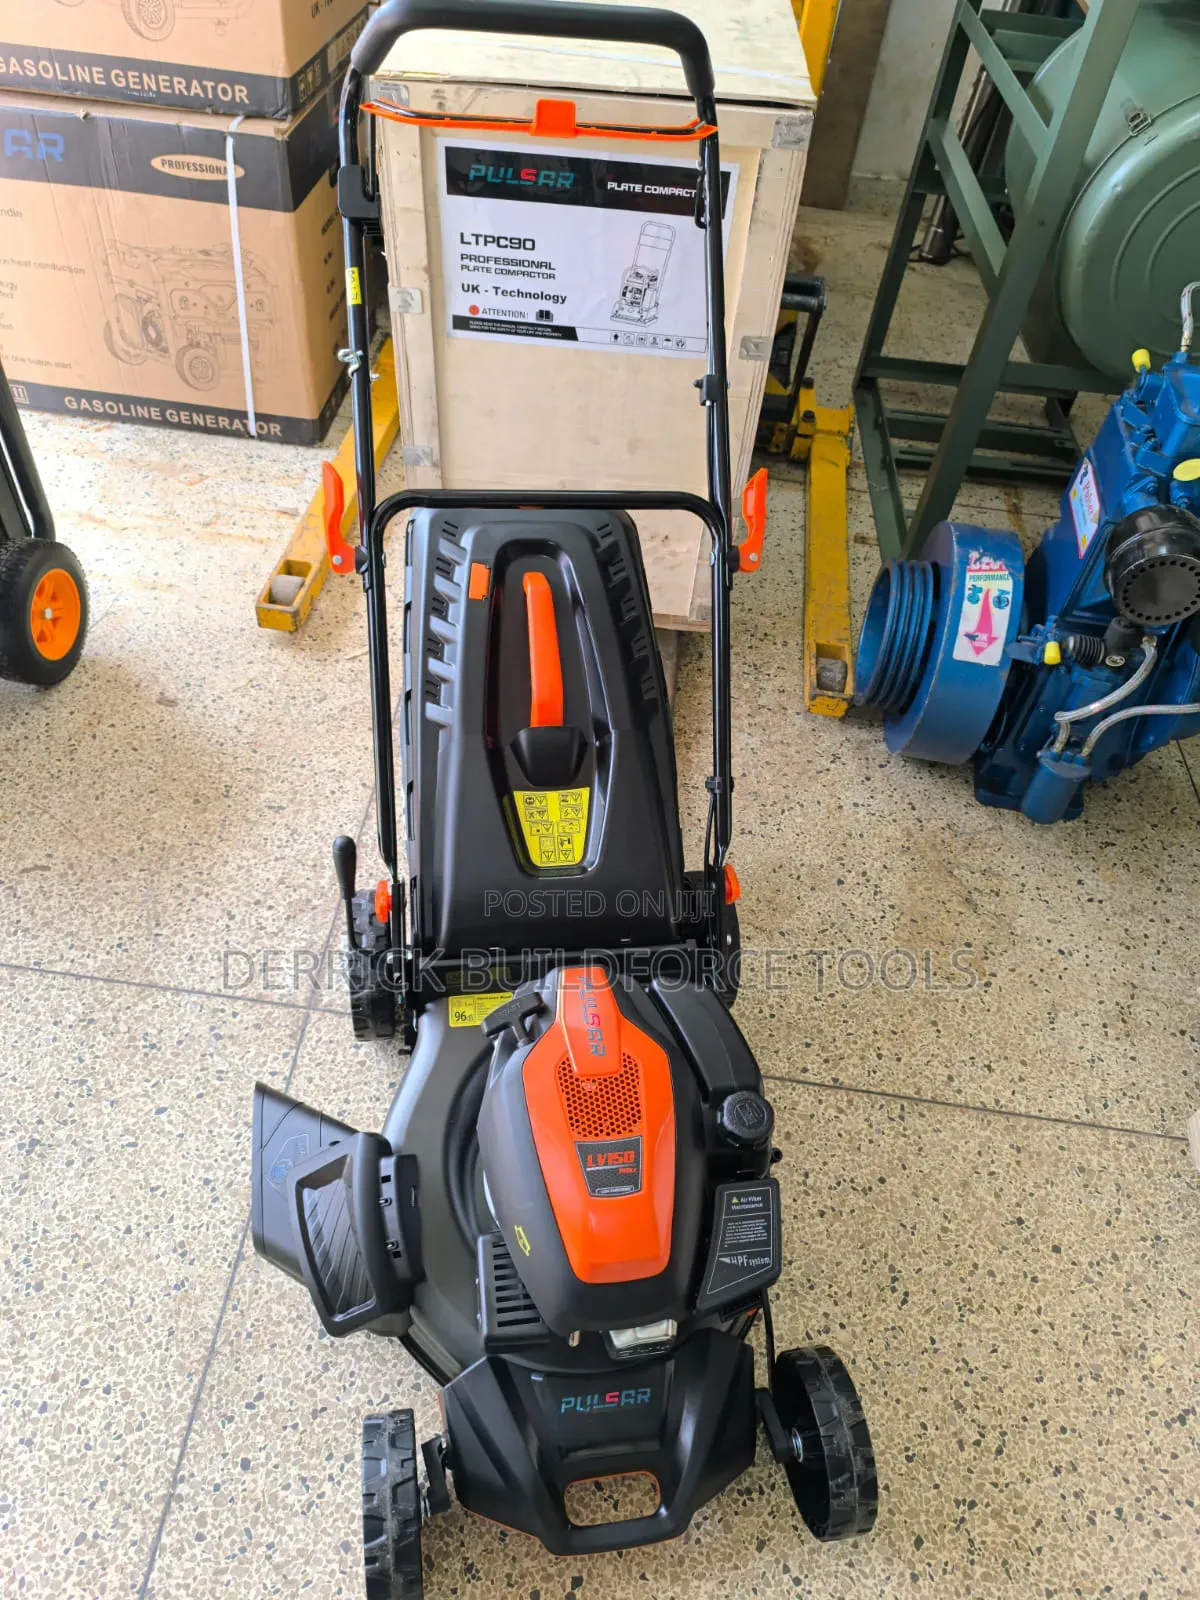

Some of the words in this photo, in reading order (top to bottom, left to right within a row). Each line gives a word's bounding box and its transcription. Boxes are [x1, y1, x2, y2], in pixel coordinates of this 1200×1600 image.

[111, 69, 249, 104] GENERATOR
[4, 128, 65, 162] AR
[161, 159, 228, 175] PROFESSIONA
[469, 164, 575, 188] PULSAR
[607, 181, 642, 192] PLATE
[644, 185, 697, 197] COMPACT
[460, 232, 536, 251] LTPC90
[461, 253, 556, 270] PROFESSIONAL
[461, 264, 492, 274] PLATE
[494, 267, 556, 280] COMPACTOR
[461, 283, 480, 293] UK
[492, 286, 567, 304] Technology
[64, 396, 162, 421] GASOLINE
[587, 1150, 635, 1167] LV150
[561, 1387, 651, 1413] PULSAR
